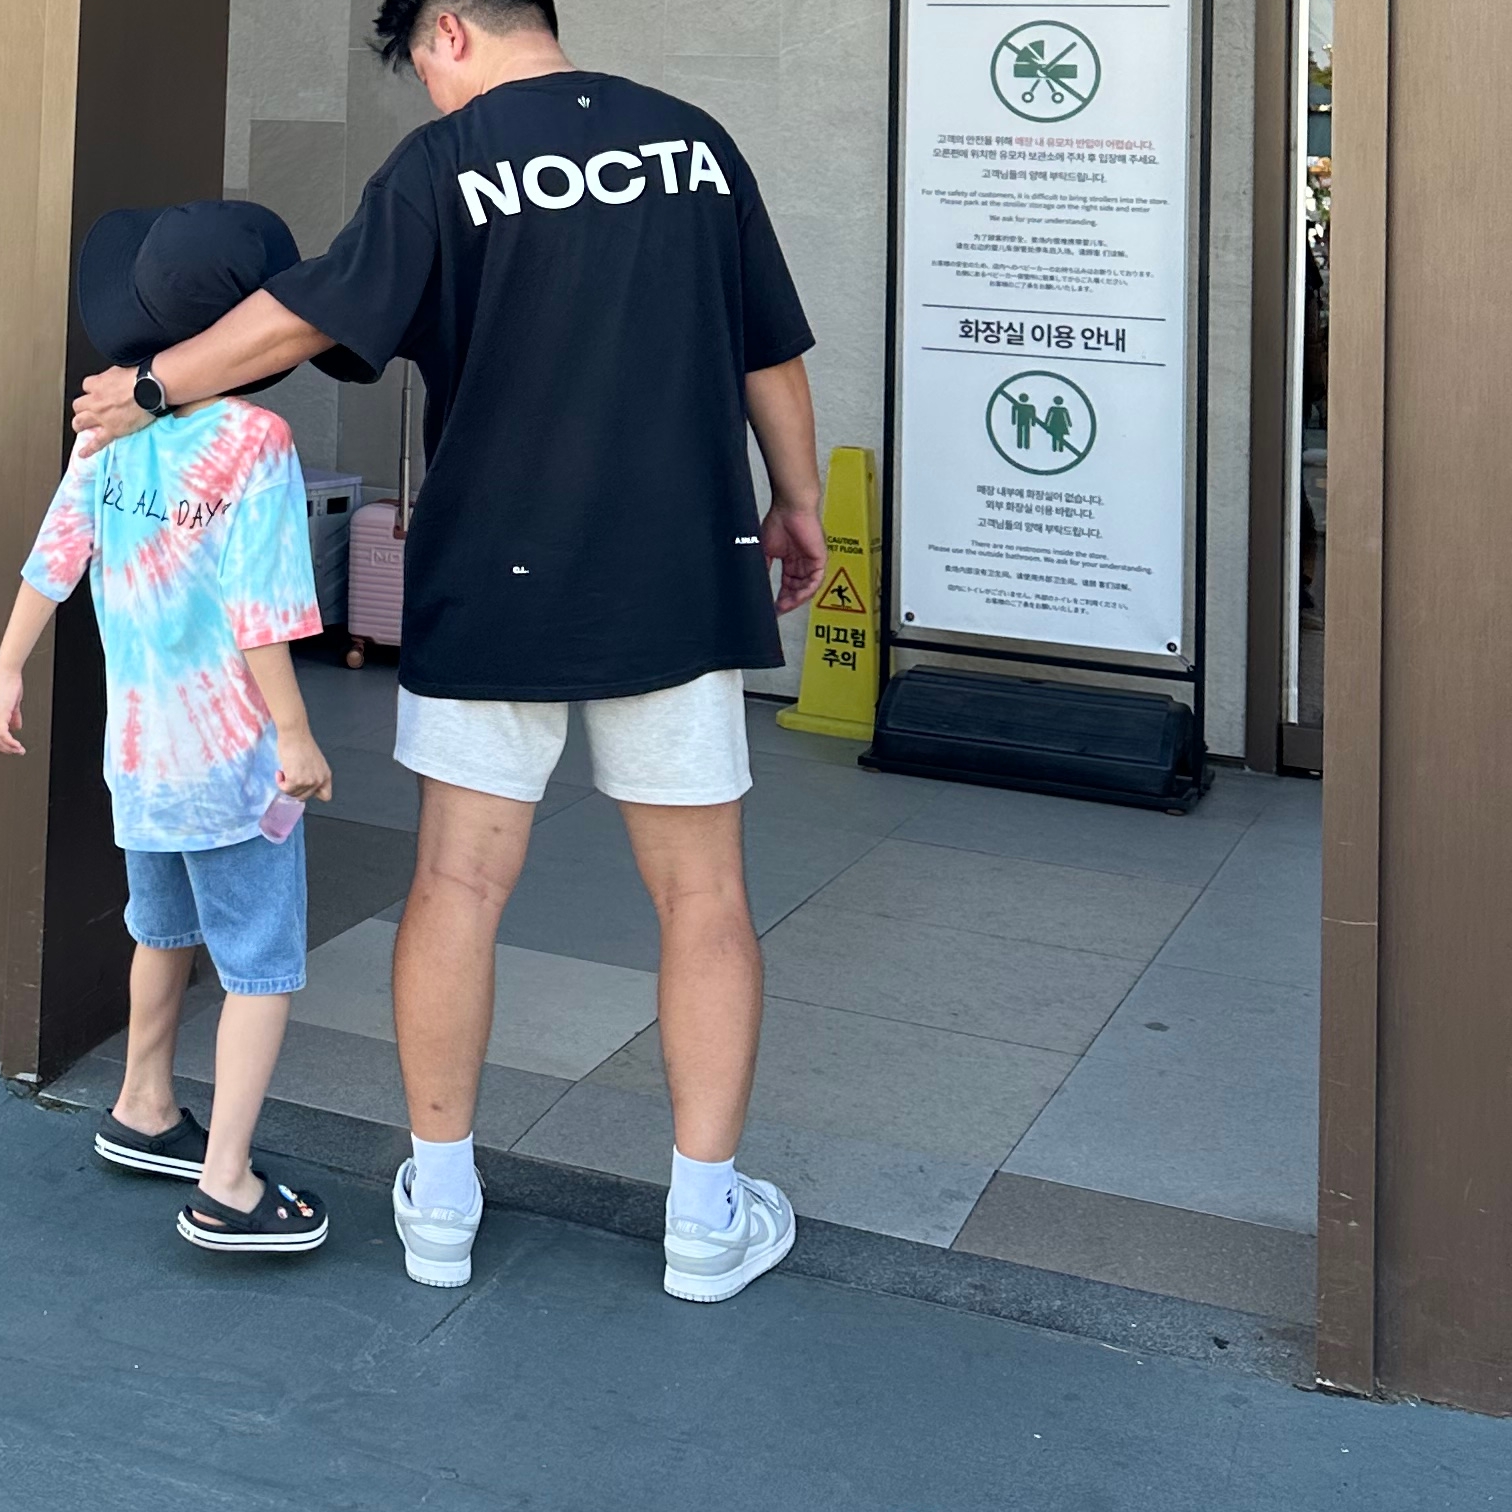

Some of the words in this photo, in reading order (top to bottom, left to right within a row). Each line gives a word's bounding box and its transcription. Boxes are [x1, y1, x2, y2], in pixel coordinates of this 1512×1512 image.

[995, 136, 1013, 146] 위해
[1047, 137, 1074, 148] 유모차
[999, 150, 1026, 160] 유모차
[1067, 152, 1085, 163] 주차
[1088, 153, 1096, 163] 후
[458, 139, 730, 226] NOCTA
[948, 189, 968, 198] safety
[963, 199, 979, 207] park
[959, 318, 1025, 346] 화장실
[1031, 323, 1075, 349] 이용
[1081, 326, 1126, 352] 안내
[976, 484, 995, 496] 매장
[996, 486, 1024, 499] 내부에
[985, 499, 1004, 511] 외부
[1006, 501, 1033, 514] 화장실
[1035, 504, 1053, 516] 이용
[977, 517, 1023, 532] 고객님들의
[827, 535, 860, 545] CAUTION
[839, 545, 864, 555] FLOOR
[928, 544, 950, 552] Please
[978, 550, 1004, 558] outside
[1043, 556, 1055, 564] We
[1069, 558, 1080, 566] for
[1082, 560, 1098, 568] your
[971, 539, 990, 549] There
[1075, 550, 1087, 558] the
[815, 624, 866, 649] 미끄럼
[822, 648, 857, 671] 주의
[430, 1207, 456, 1221] NIKE
[675, 1219, 699, 1234] NIKE
